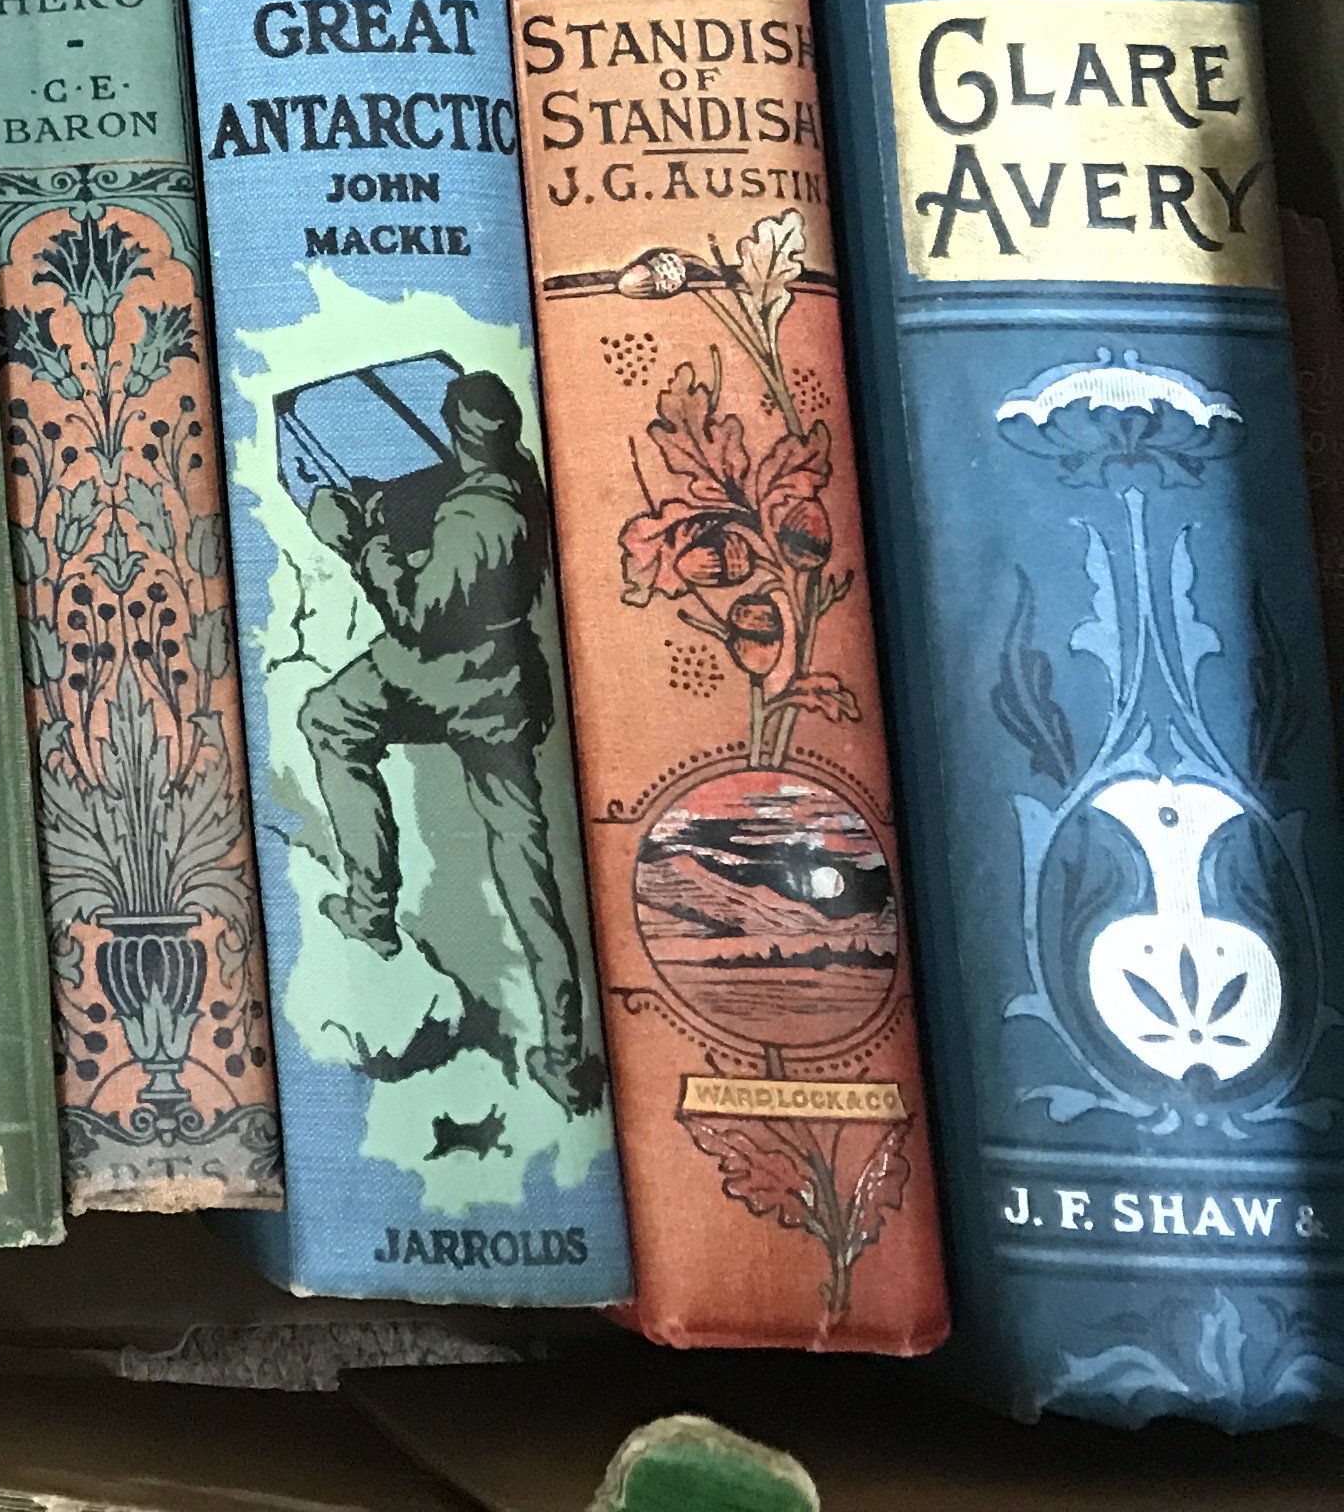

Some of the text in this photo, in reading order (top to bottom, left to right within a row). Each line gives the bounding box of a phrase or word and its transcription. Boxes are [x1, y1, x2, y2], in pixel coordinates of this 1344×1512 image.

[521, 14, 815, 77] STANDISH
[659, 66, 722, 92] OF
[2, 111, 159, 145] BARON
[207, 92, 517, 162] ANTARCTIC
[540, 88, 822, 153] STANDISH
[325, 172, 441, 204] JOHN
[914, 143, 1276, 259] AVERY
[303, 225, 472, 258] MACKIE
[1003, 1186, 1045, 1228] J.
[1056, 1189, 1095, 1231] F.
[1112, 1192, 1283, 1238] SHAW
[373, 1225, 590, 1271] JARROLDS
